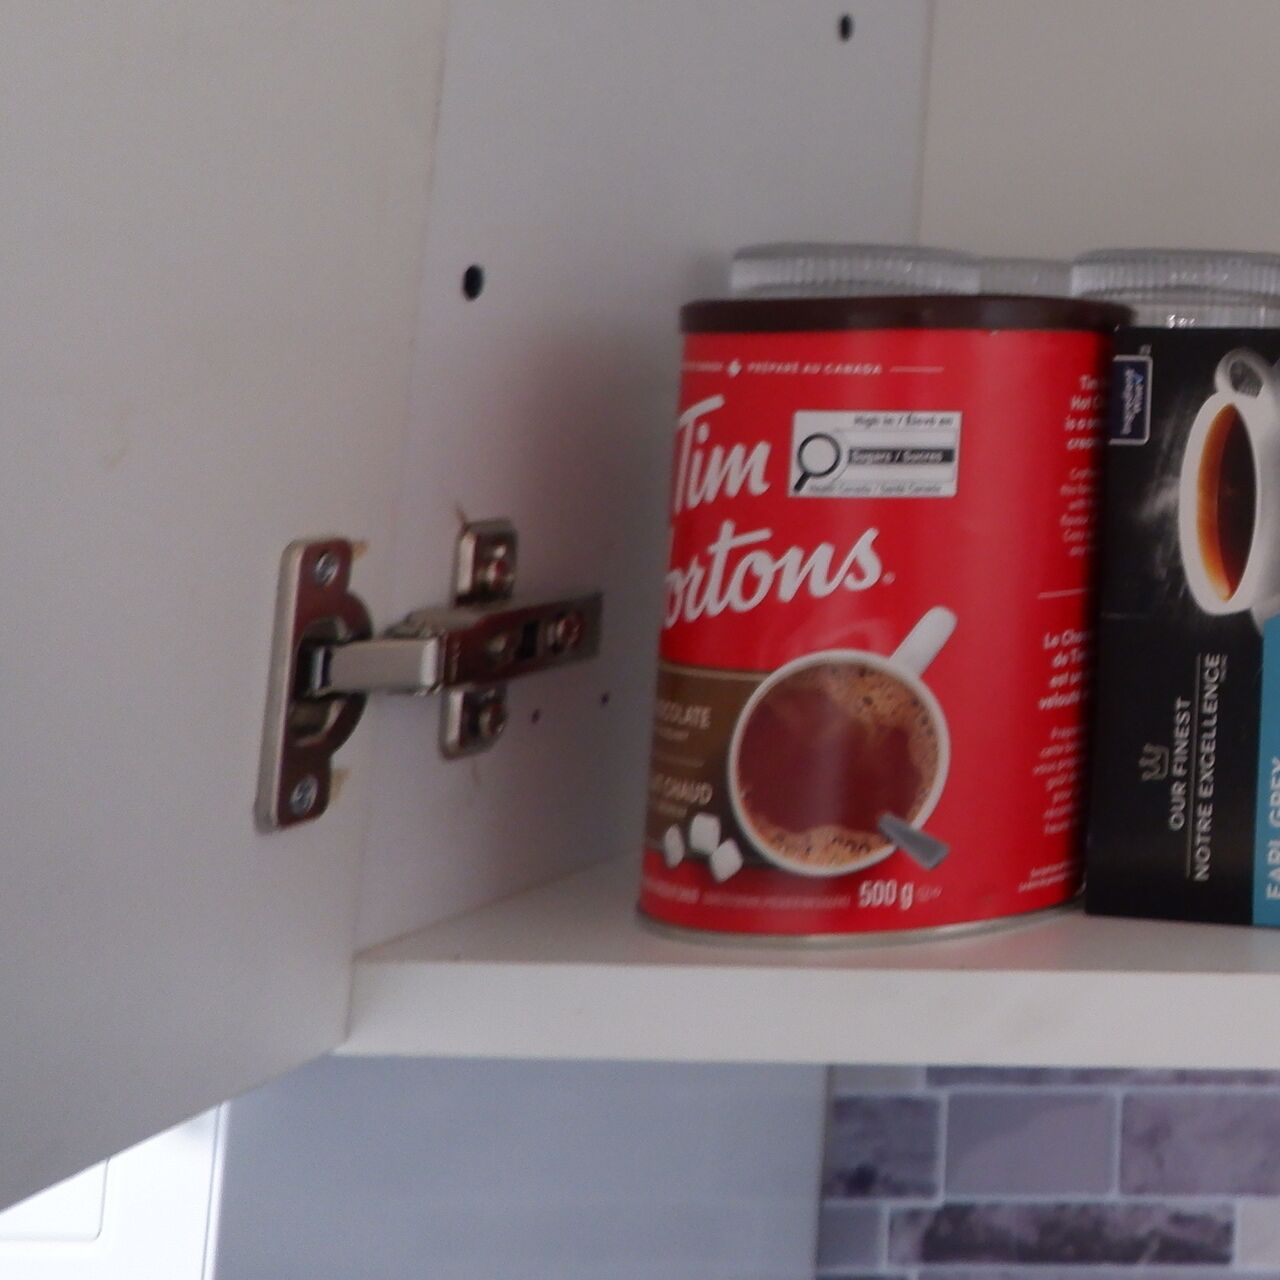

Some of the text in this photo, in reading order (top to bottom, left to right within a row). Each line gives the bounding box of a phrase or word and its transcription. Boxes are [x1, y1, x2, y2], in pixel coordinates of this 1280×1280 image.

[675, 394, 772, 516] Tim
[1168, 695, 1192, 831] OUR FINEST
[1194, 652, 1222, 882] NOTRE EXCELLENCE
[858, 881, 896, 908] 500
[899, 883, 914, 910] g
